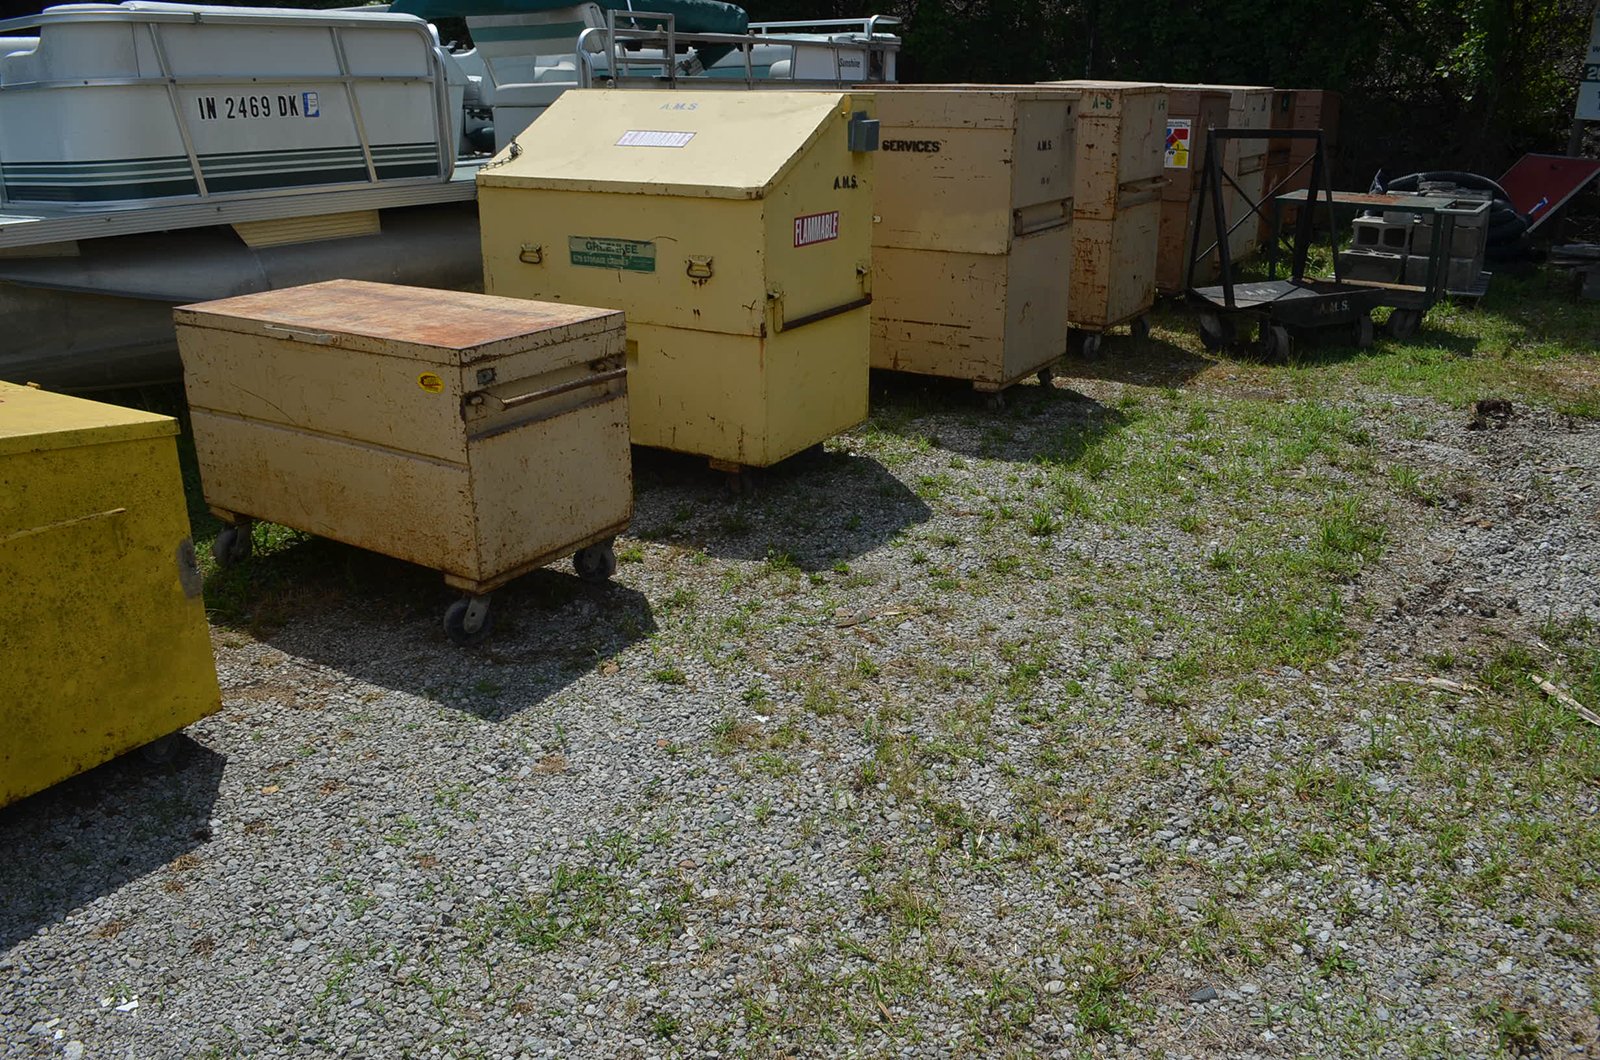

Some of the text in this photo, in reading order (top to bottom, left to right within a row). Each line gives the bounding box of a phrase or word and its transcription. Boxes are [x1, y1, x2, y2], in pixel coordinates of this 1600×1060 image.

[198, 97, 217, 120] IN
[225, 96, 271, 119] 2469
[278, 95, 299, 116] DK
[881, 139, 941, 153] SERVICES
[795, 211, 839, 247] FLAMMABLE
